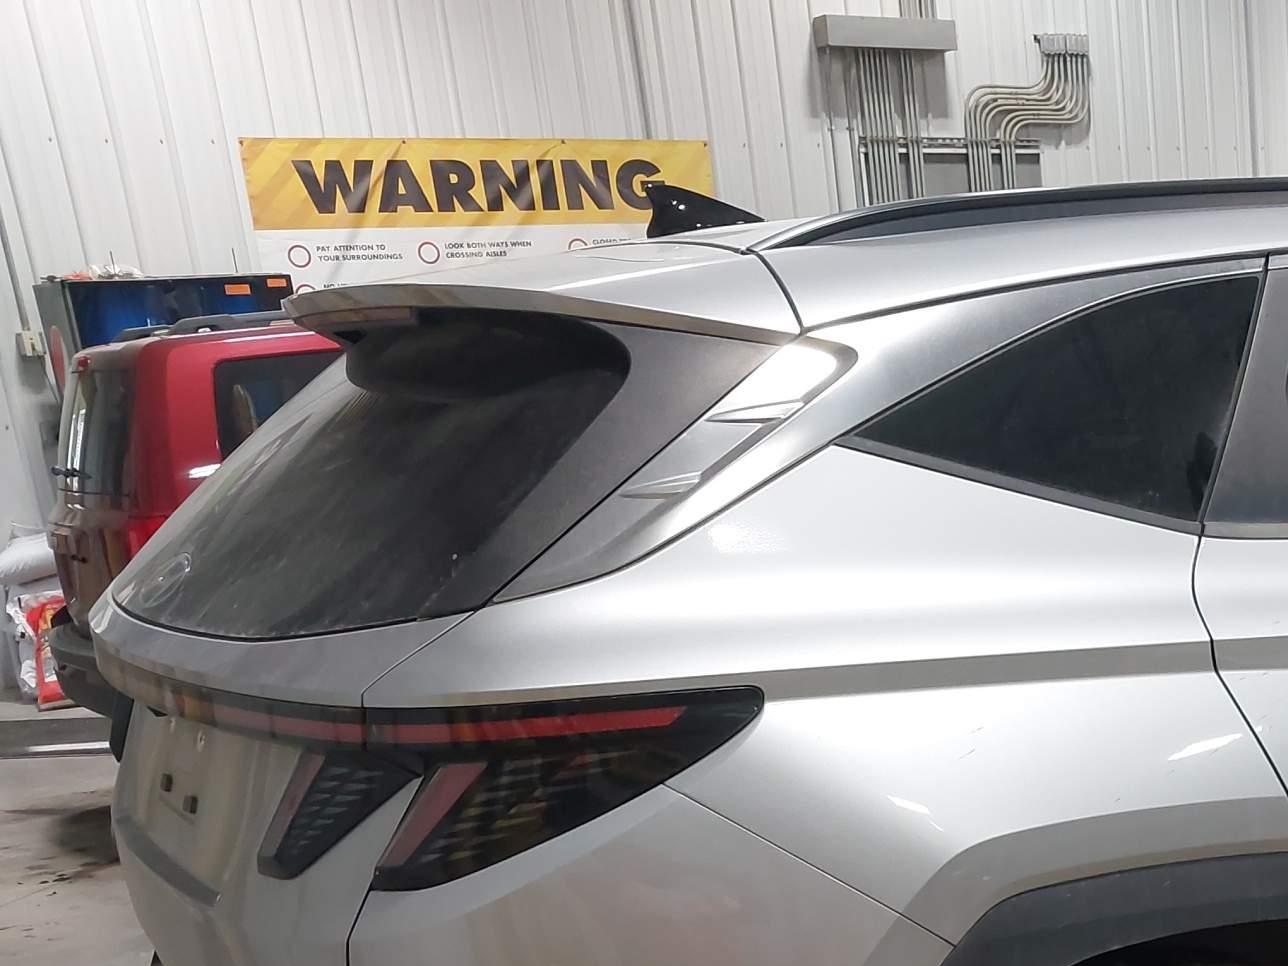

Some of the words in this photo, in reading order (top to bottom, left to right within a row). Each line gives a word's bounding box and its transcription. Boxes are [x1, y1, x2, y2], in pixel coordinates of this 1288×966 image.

[291, 158, 665, 214] WARNING
[333, 244, 374, 252] ATTENTION
[444, 242, 465, 250] LOOK
[466, 241, 487, 249] BOTH
[318, 254, 340, 262] YOUR
[341, 253, 404, 261] SURROUNDINGS
[445, 251, 484, 259] CROSSING
